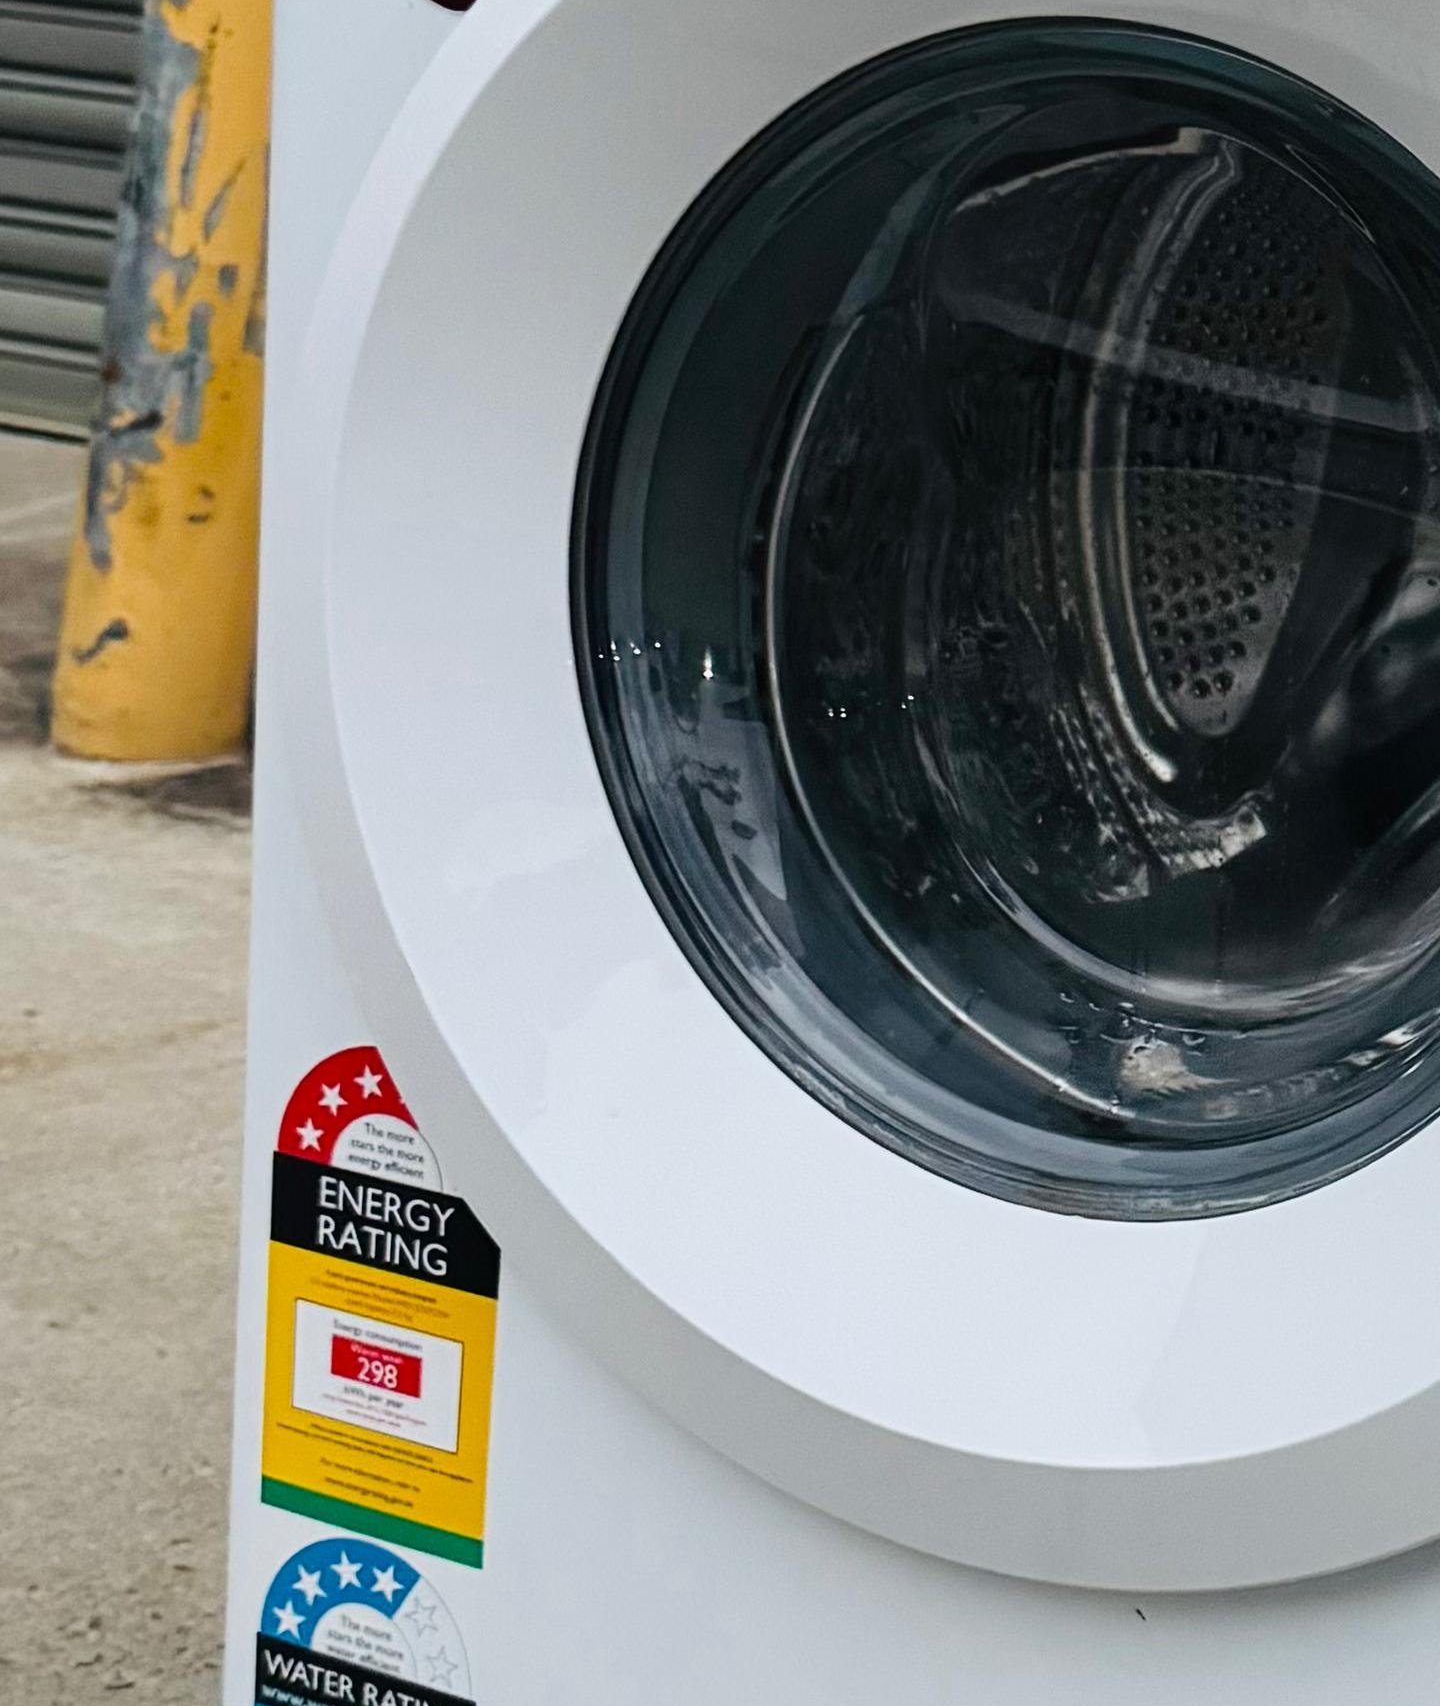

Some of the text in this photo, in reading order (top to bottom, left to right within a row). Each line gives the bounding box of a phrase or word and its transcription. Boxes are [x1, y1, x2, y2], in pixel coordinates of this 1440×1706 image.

[365, 1122, 414, 1145] The more
[349, 1155, 381, 1169] energy
[351, 1139, 424, 1163] stars the more
[320, 1176, 455, 1236] ENERGY
[318, 1215, 448, 1276] RATING
[357, 1357, 398, 1389] 298
[264, 1649, 354, 1703] WATER
